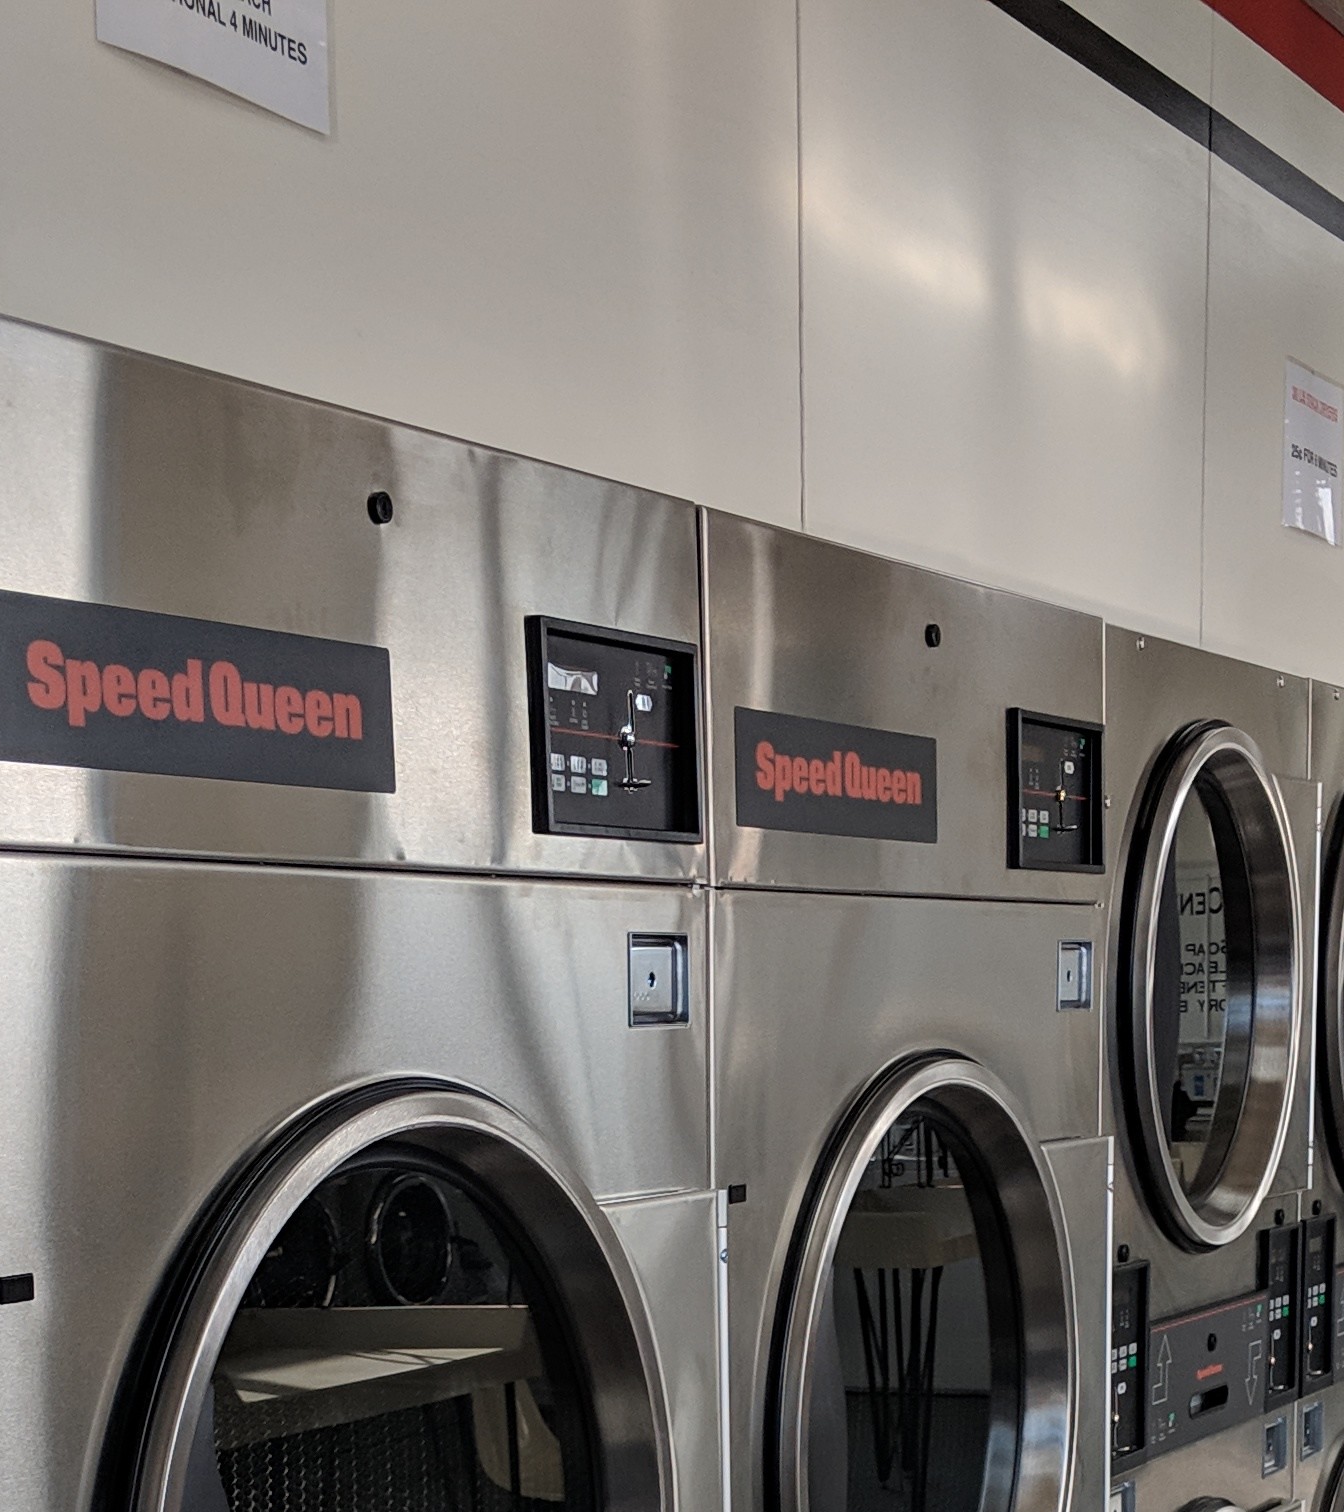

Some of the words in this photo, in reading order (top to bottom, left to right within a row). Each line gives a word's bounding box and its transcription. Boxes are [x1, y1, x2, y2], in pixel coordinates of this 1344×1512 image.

[229, 10, 238, 32] 4
[242, 14, 308, 65] MINUTES
[26, 638, 205, 728] Speed
[209, 660, 364, 741] Queen
[755, 740, 842, 802] Speed
[844, 751, 923, 805] Queen
